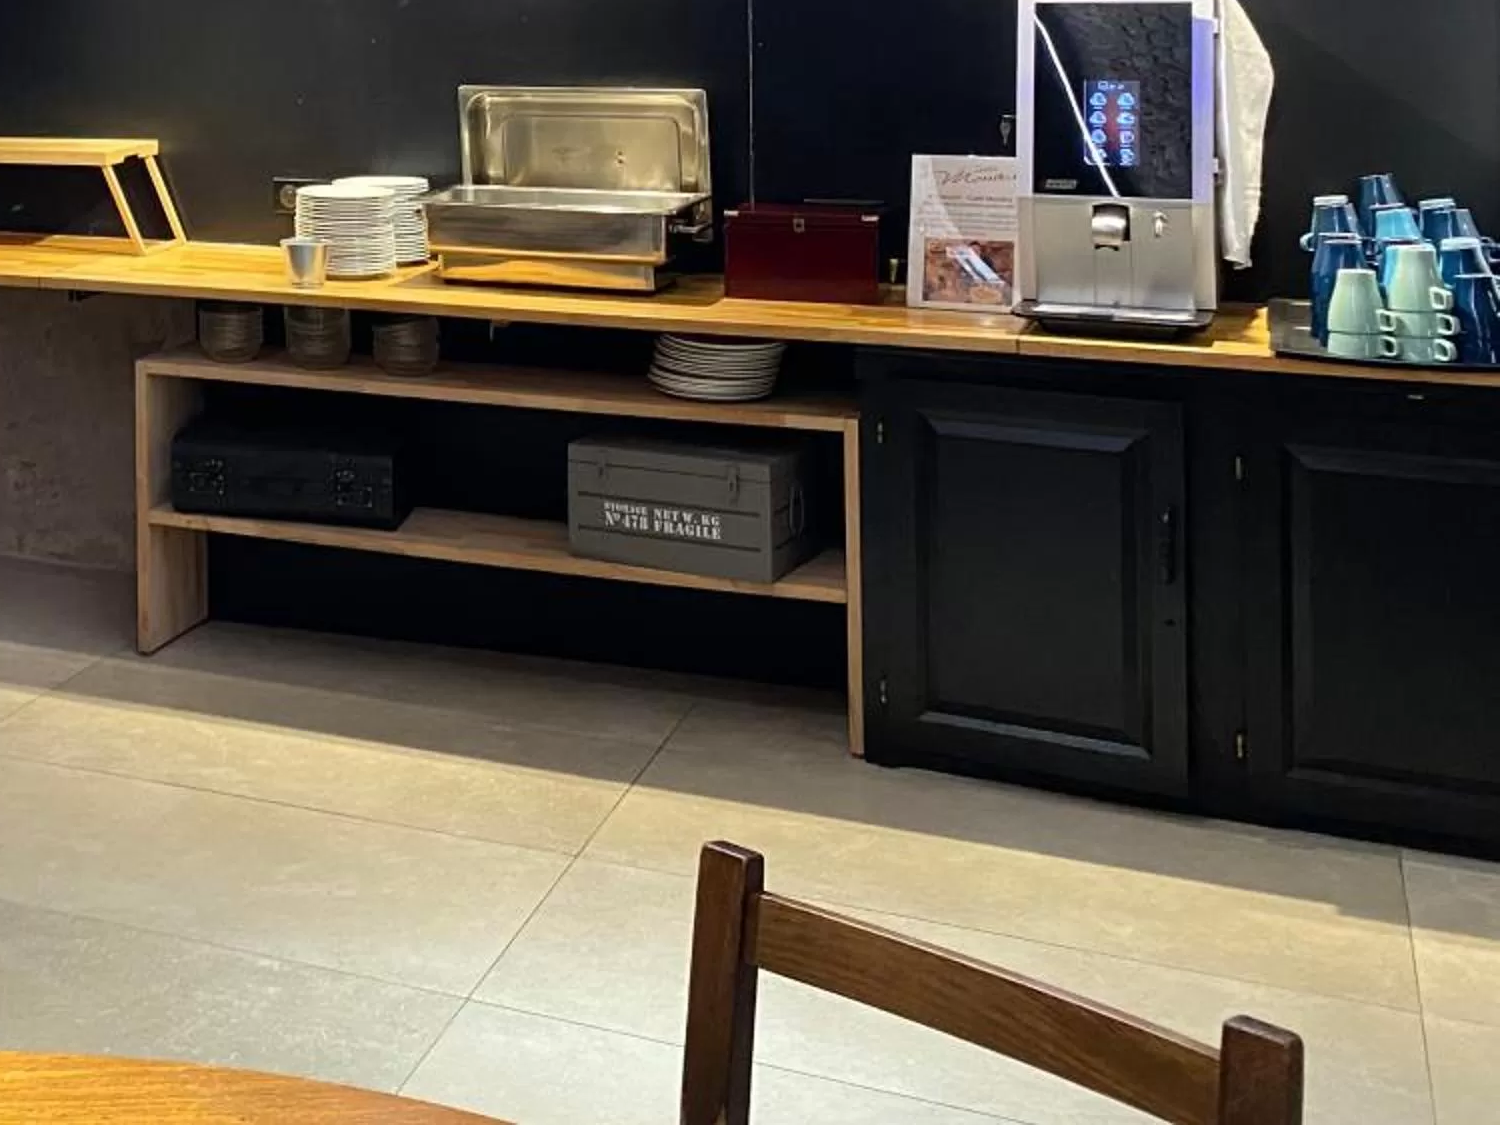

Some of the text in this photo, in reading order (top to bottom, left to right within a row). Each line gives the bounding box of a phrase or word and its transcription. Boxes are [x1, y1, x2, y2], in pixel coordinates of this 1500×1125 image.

[653, 508, 679, 522] NET
[701, 514, 720, 526] KG
[653, 520, 721, 540] FRAGILE
